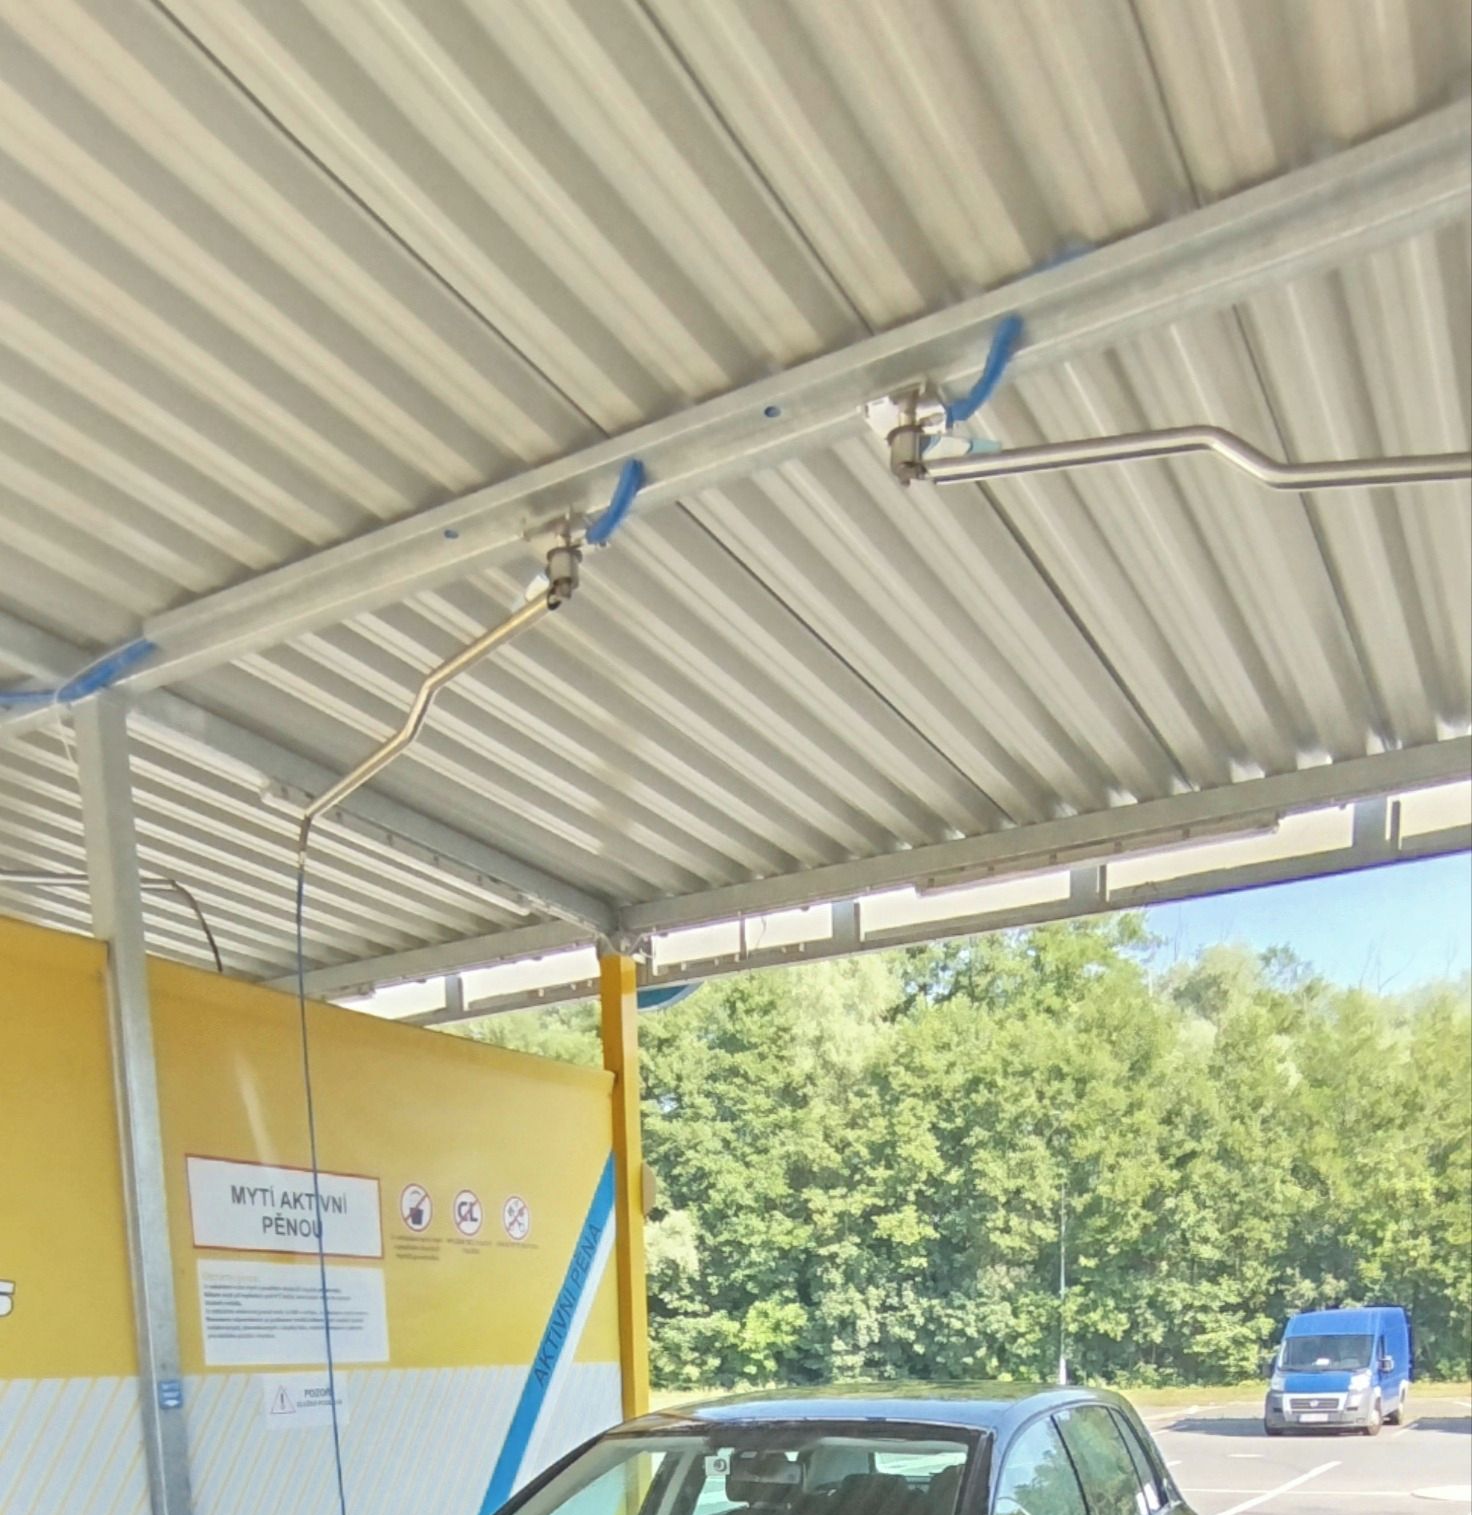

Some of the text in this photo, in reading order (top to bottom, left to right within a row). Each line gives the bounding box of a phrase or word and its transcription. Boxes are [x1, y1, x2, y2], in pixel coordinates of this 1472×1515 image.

[230, 1184, 347, 1214] MYTÍ AKTVNÍ
[262, 1212, 322, 1238] PĚNOU
